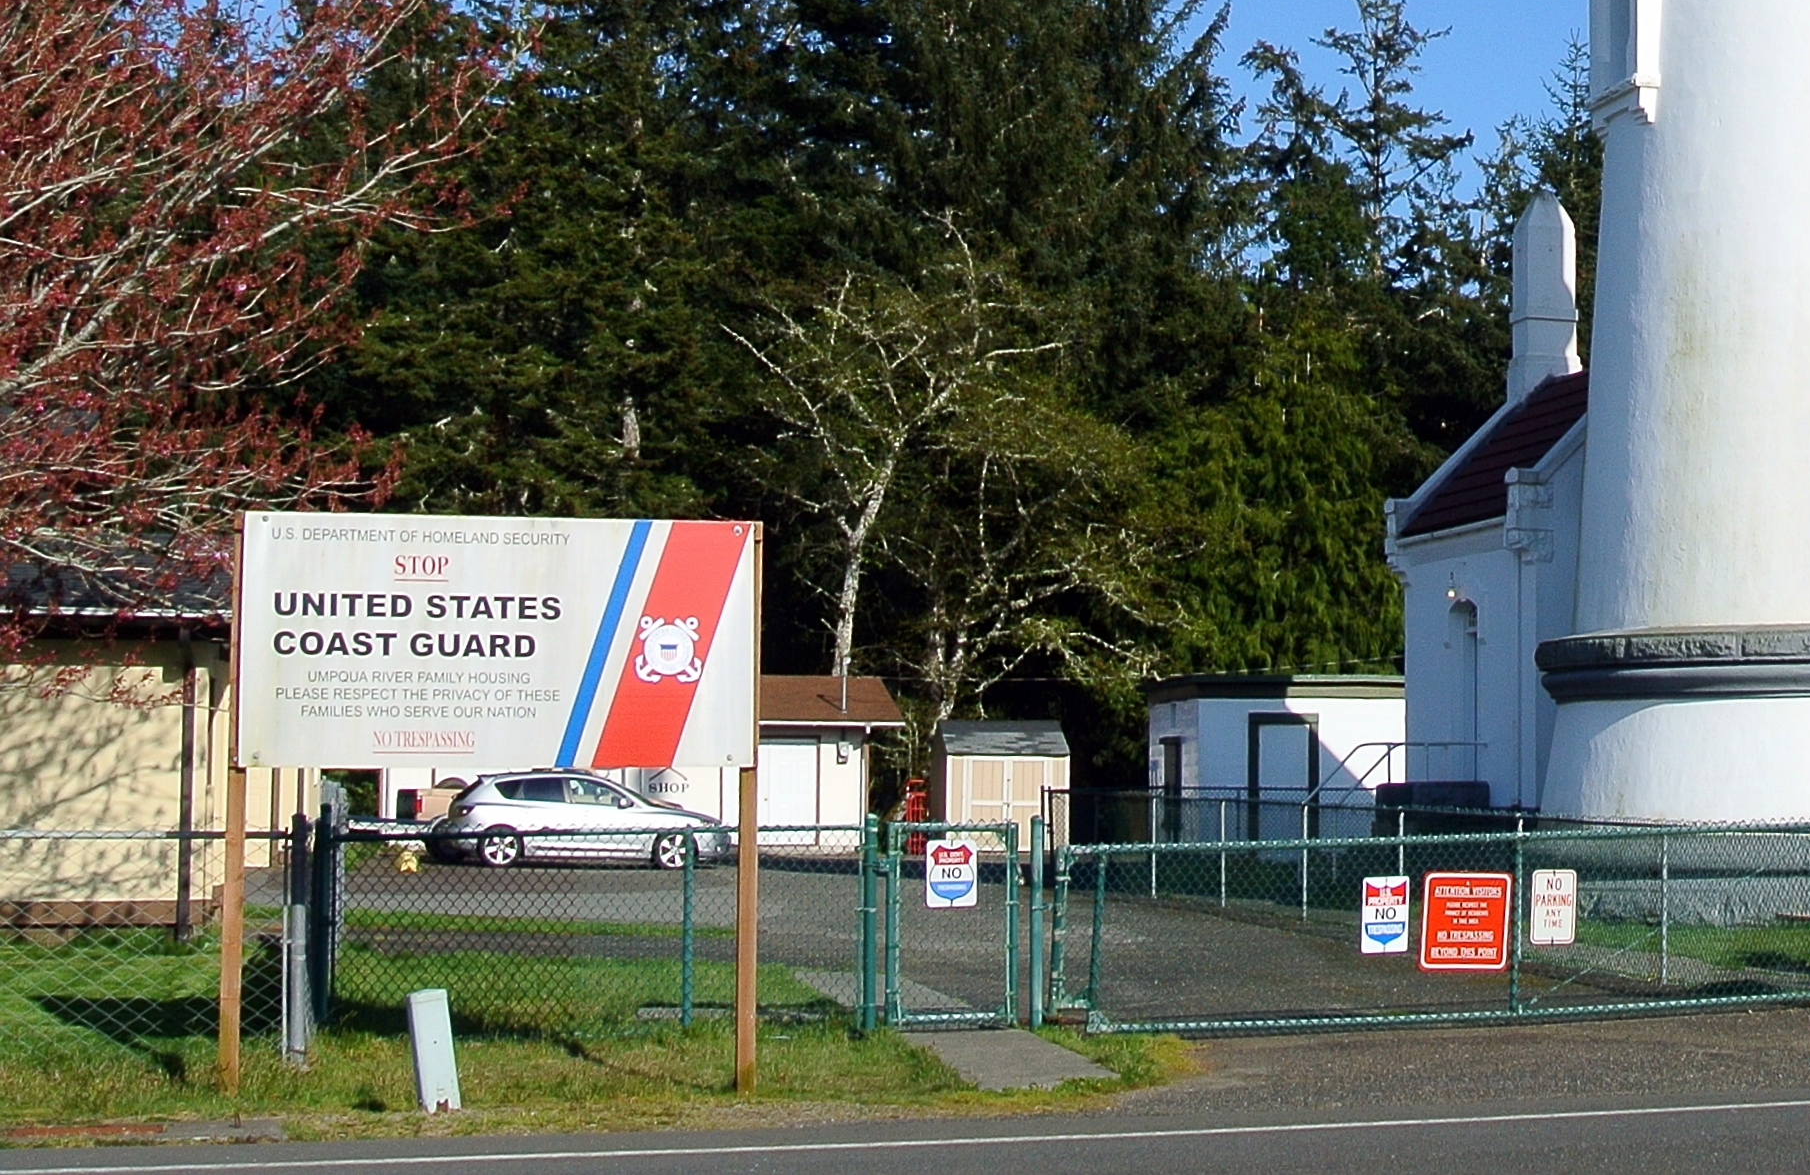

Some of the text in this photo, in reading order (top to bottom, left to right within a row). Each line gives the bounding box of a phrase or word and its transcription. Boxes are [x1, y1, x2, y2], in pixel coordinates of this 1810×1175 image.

[272, 527, 570, 545] U.S. DEPARTMENT OF HOMELAND SECURITY
[394, 554, 449, 576] STOP
[274, 592, 562, 620] UNITED STATES
[273, 631, 536, 658] COAST GUARD
[308, 670, 530, 684] UMPQUA RIVER FAMILY HOUSING
[275, 687, 560, 702] PLEASE RESPECT THE PRIVACY OF THESE
[301, 705, 537, 719] FAMILIES WHO SERVE OUR NATION
[373, 730, 474, 748] NO TRESPASSING
[648, 782, 689, 793] SHOP
[942, 867, 962, 879] NO
[1547, 878, 1562, 891] NO
[1434, 886, 1502, 897] ATTENTION VISITORS
[1368, 895, 1404, 906] PROPERTY
[1535, 894, 1572, 906] PARKING
[1375, 907, 1396, 920] NO
[1545, 909, 1561, 917] ANY
[1544, 919, 1563, 928] TIME
[1437, 930, 1494, 941] NO TRESPASSING
[1430, 947, 1497, 958] BEYOND THIS POINT
